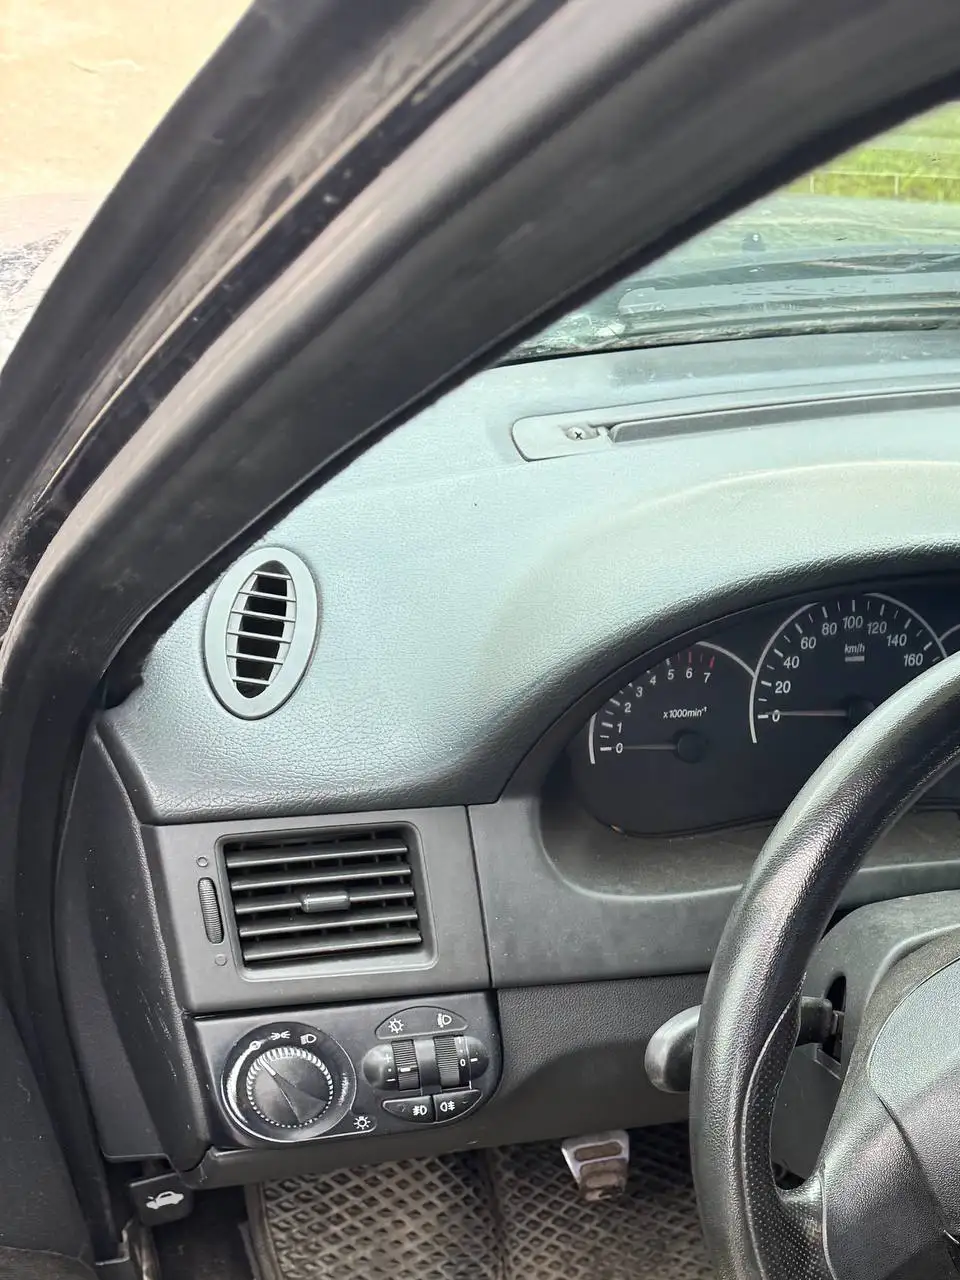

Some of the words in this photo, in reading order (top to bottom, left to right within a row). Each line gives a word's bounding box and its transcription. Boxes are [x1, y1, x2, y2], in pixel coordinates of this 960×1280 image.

[821, 622, 837, 636] 80
[842, 616, 864, 629] 100
[867, 621, 887, 634] 120
[800, 636, 817, 650] 60
[886, 633, 907, 647] 140
[844, 643, 865, 653] km/h
[783, 655, 800, 669] 40
[903, 653, 924, 667] 160
[667, 669, 675, 680] 5
[685, 667, 693, 679] 6
[703, 672, 711, 683] 7
[649, 675, 657, 685] 4
[635, 686, 643, 697] 3
[775, 680, 791, 694] 20
[624, 702, 632, 713] 2
[771, 709, 780, 722] 0
[615, 743, 623, 754] 0
